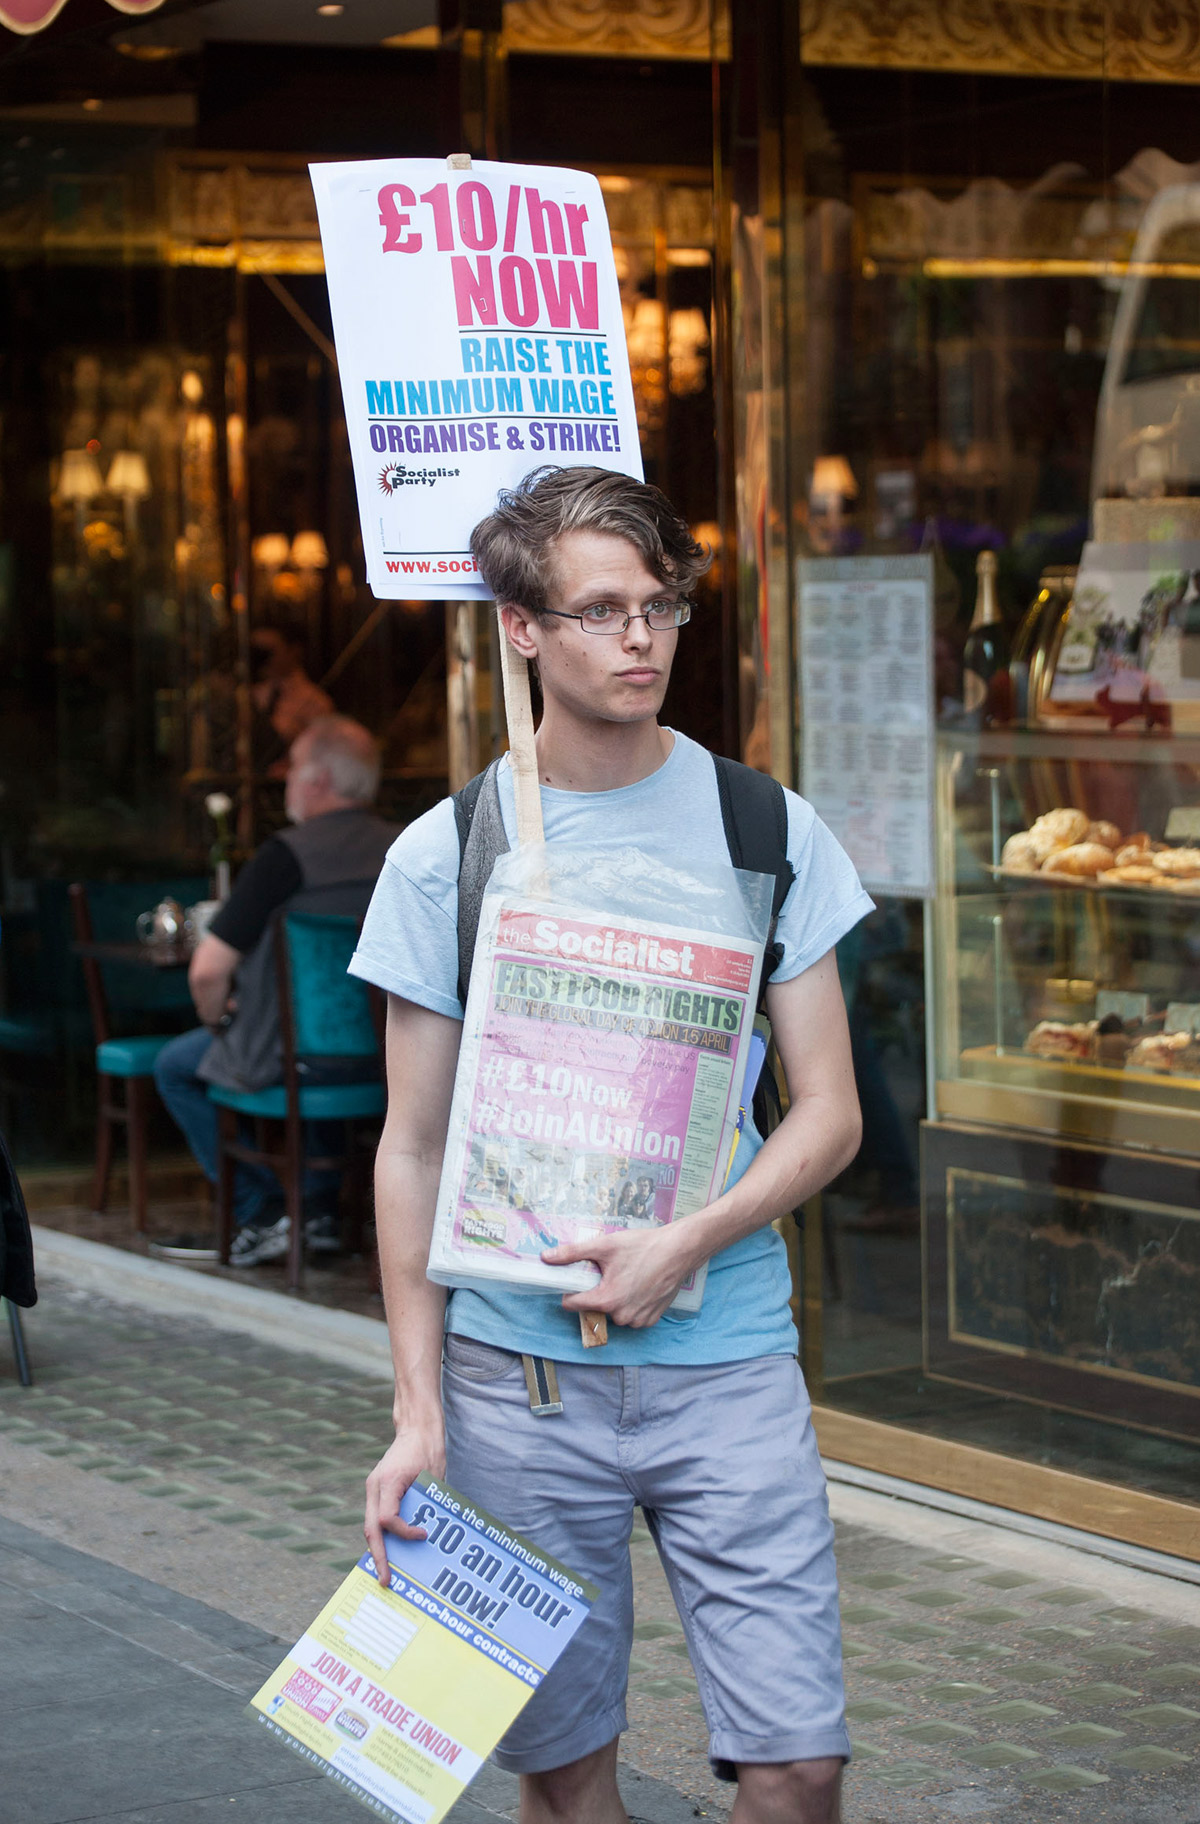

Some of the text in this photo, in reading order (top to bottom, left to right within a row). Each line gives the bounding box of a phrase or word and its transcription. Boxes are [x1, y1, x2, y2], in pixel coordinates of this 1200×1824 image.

[377, 181, 589, 256] £10/hr
[451, 255, 600, 330] NOW
[460, 337, 612, 375] RAISE THE
[365, 378, 616, 415] MINIMUM WAGE
[369, 422, 621, 453] ORGANISE & STRIKE!
[395, 465, 460, 478] Socialist
[385, 556, 480, 573] www.soci
[503, 920, 695, 976] the Socialist
[525, 998, 546, 1016] THE
[548, 1003, 595, 1026] GLOBAL
[597, 1012, 618, 1028] DAY
[680, 1028, 700, 1044] 15
[700, 1031, 728, 1052] APRIL
[481, 1056, 633, 1109] #£10Now
[673, 1064, 690, 1074] pay
[682, 1051, 696, 1060] US
[476, 1096, 681, 1160] #JoinAUnion
[426, 1482, 583, 1598] Raise the minimum wage
[431, 1566, 510, 1630] now!
[460, 1543, 503, 1584] an
[499, 1564, 573, 1629] hour
[405, 1585, 474, 1638] zero-hour
[473, 1631, 541, 1686] contracts
[281, 1686, 308, 1708] UNION
[311, 1652, 351, 1686] JOIN
[345, 1676, 363, 1696] A
[360, 1683, 415, 1732] TRADE
[410, 1719, 463, 1766] UNION
